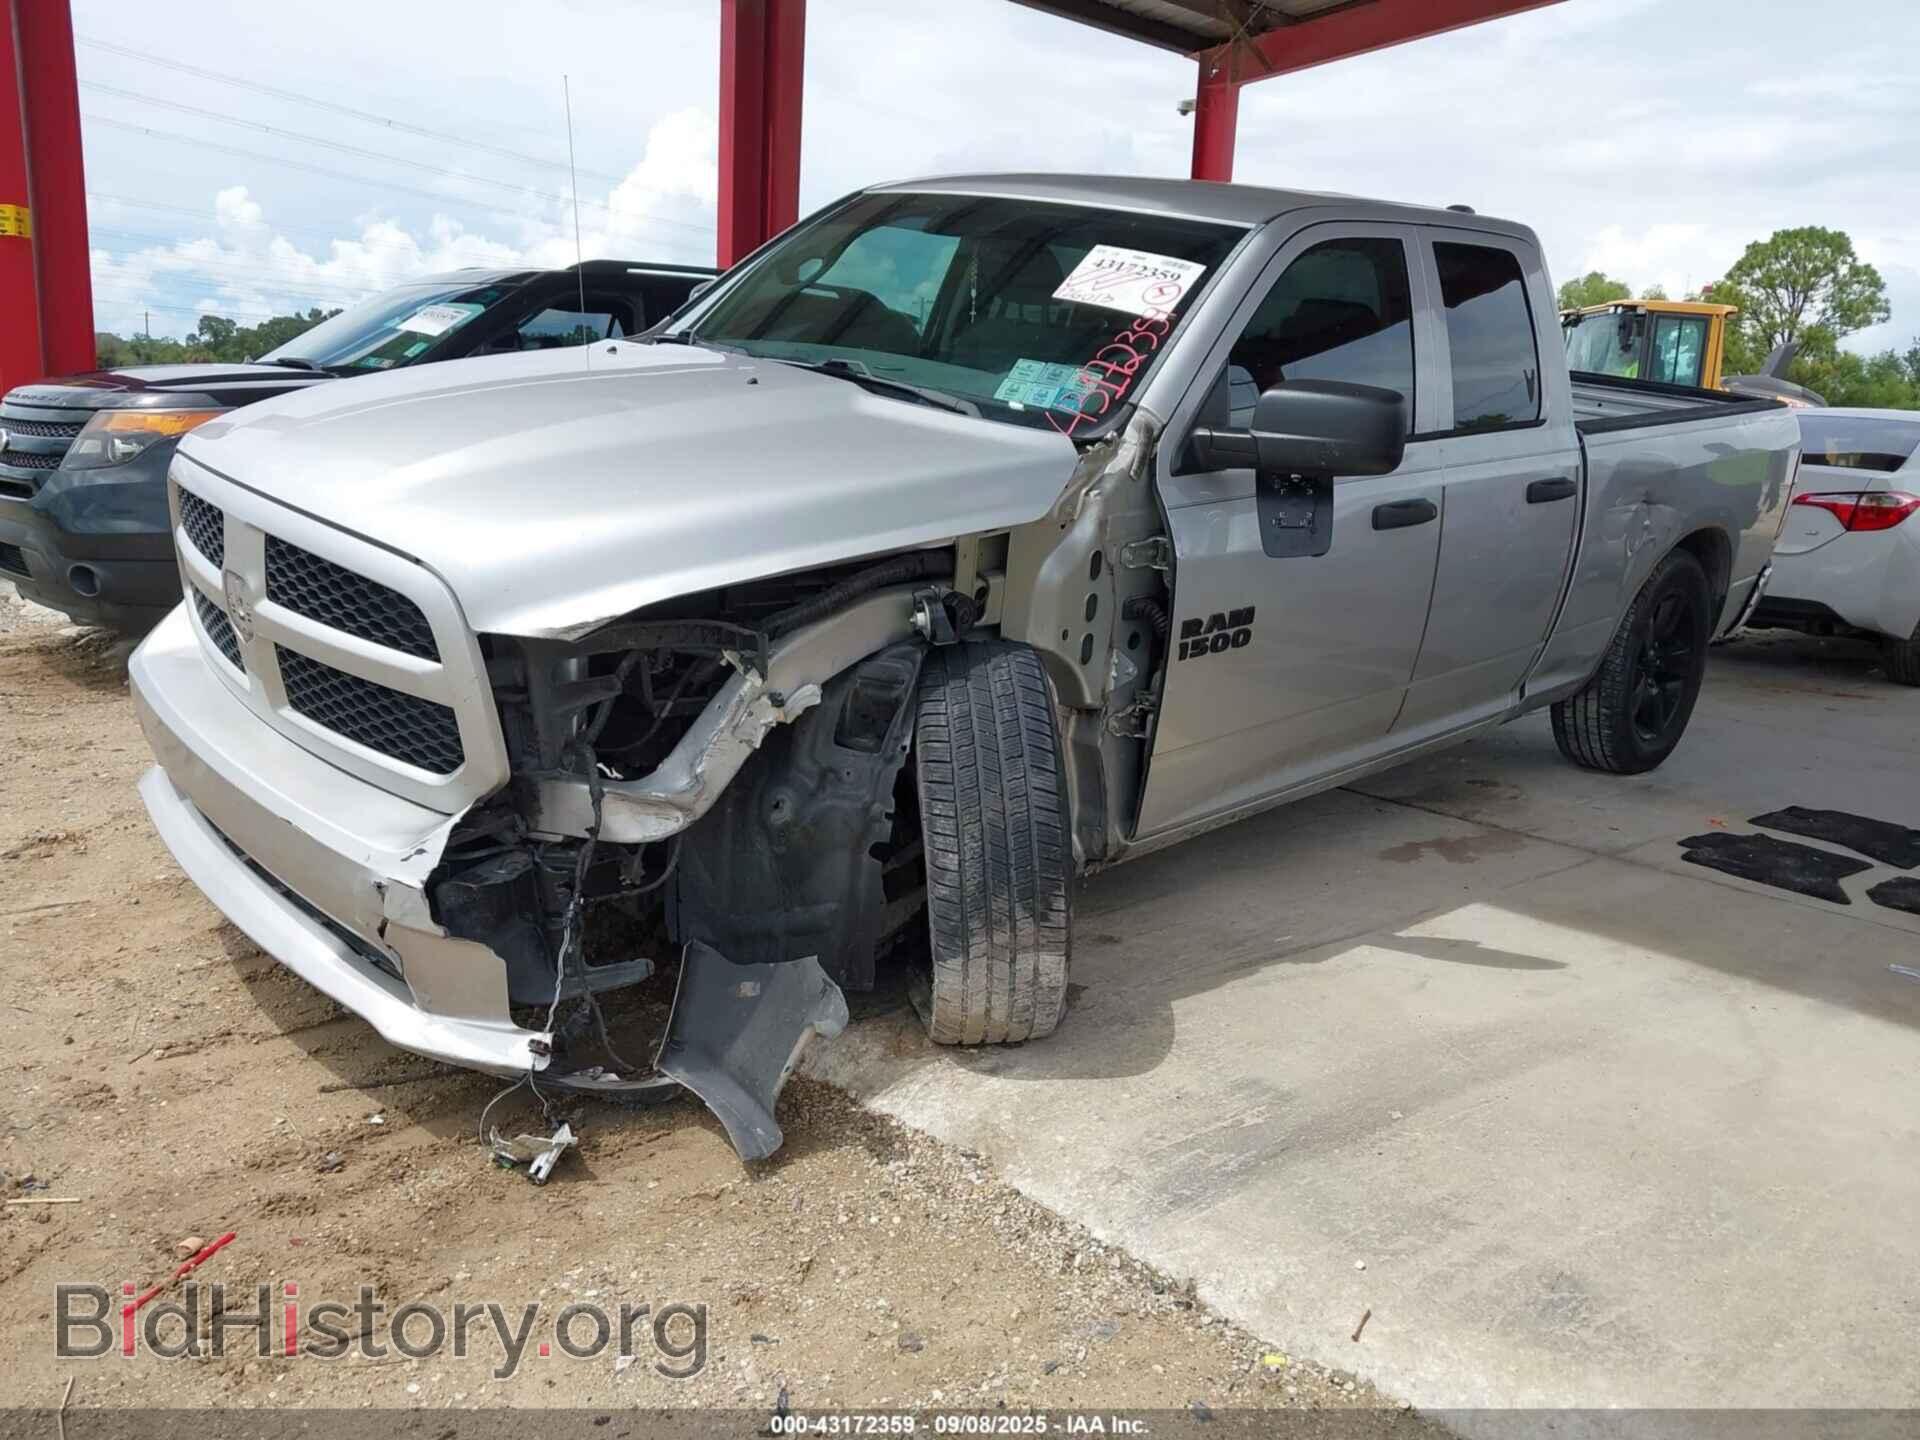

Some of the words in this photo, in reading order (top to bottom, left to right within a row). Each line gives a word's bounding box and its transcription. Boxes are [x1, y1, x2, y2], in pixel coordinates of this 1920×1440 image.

[1093, 258, 1182, 282] 43172359
[1180, 606, 1255, 640] RAM
[1178, 627, 1252, 661] 1500
